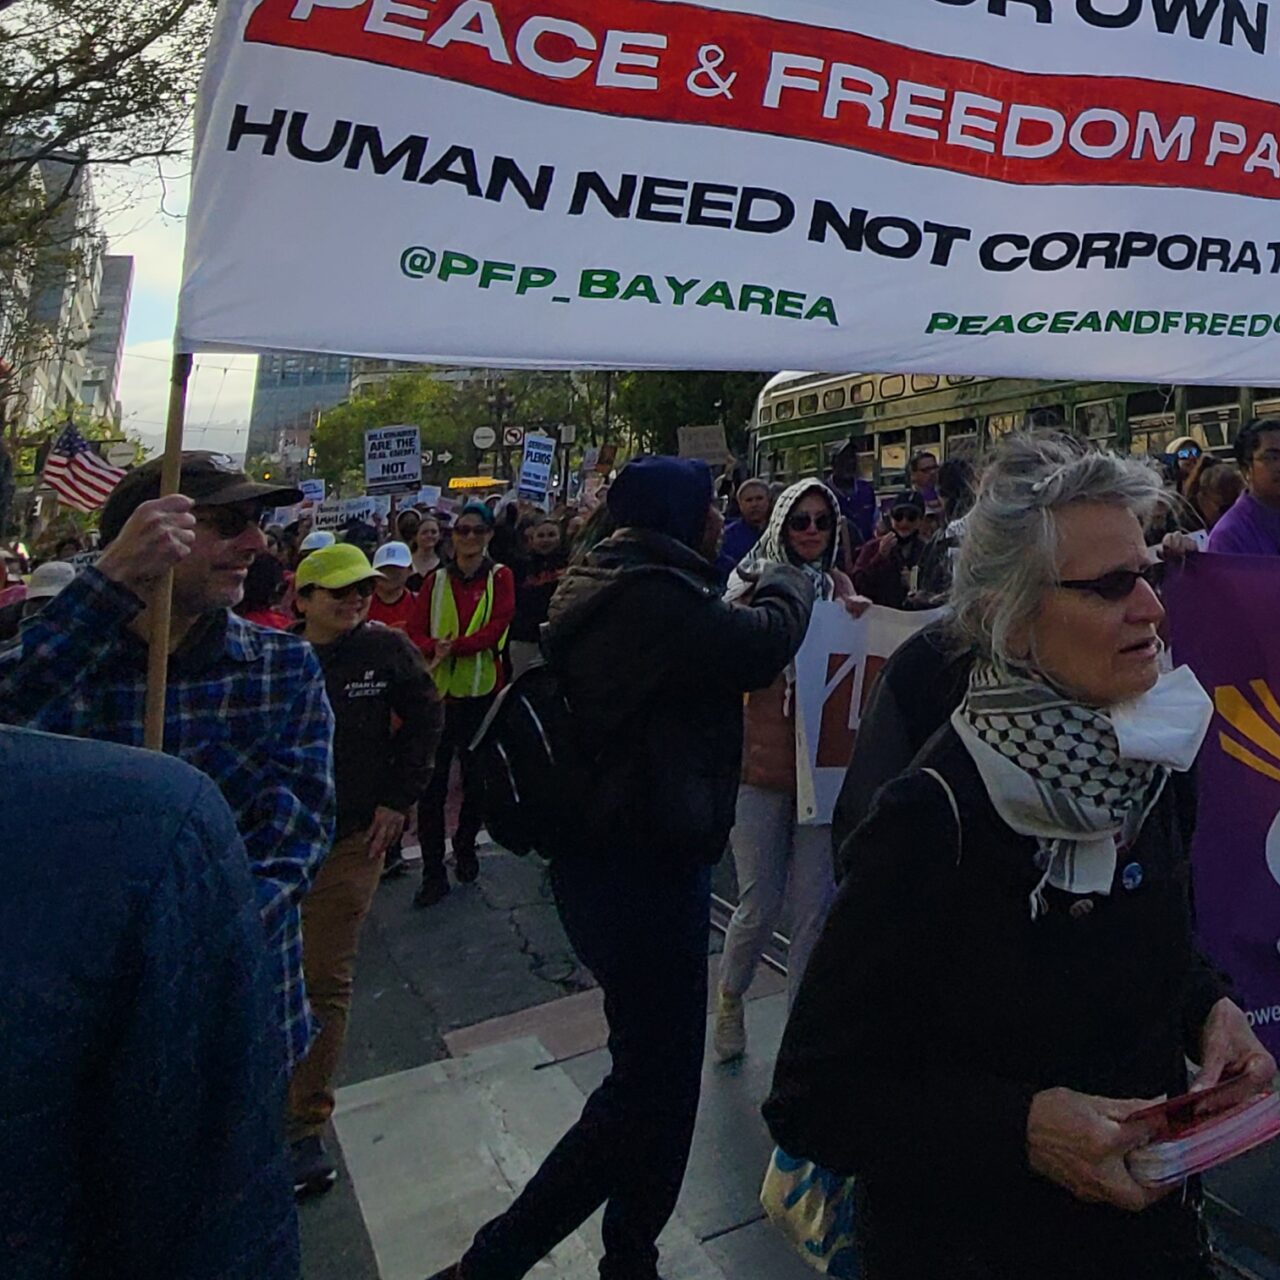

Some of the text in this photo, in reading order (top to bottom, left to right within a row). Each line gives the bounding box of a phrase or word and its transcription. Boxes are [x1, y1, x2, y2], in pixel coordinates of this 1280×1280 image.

[686, 44, 737, 99] &
[762, 52, 1197, 162] FREEDOM
[226, 103, 555, 211] HUMAN
[568, 171, 795, 234] NEED
[807, 199, 970, 268] NOT
[399, 245, 839, 326] @PFP_BAYAREA
[370, 437, 416, 452] ARE THE
[381, 461, 406, 475] NOT
